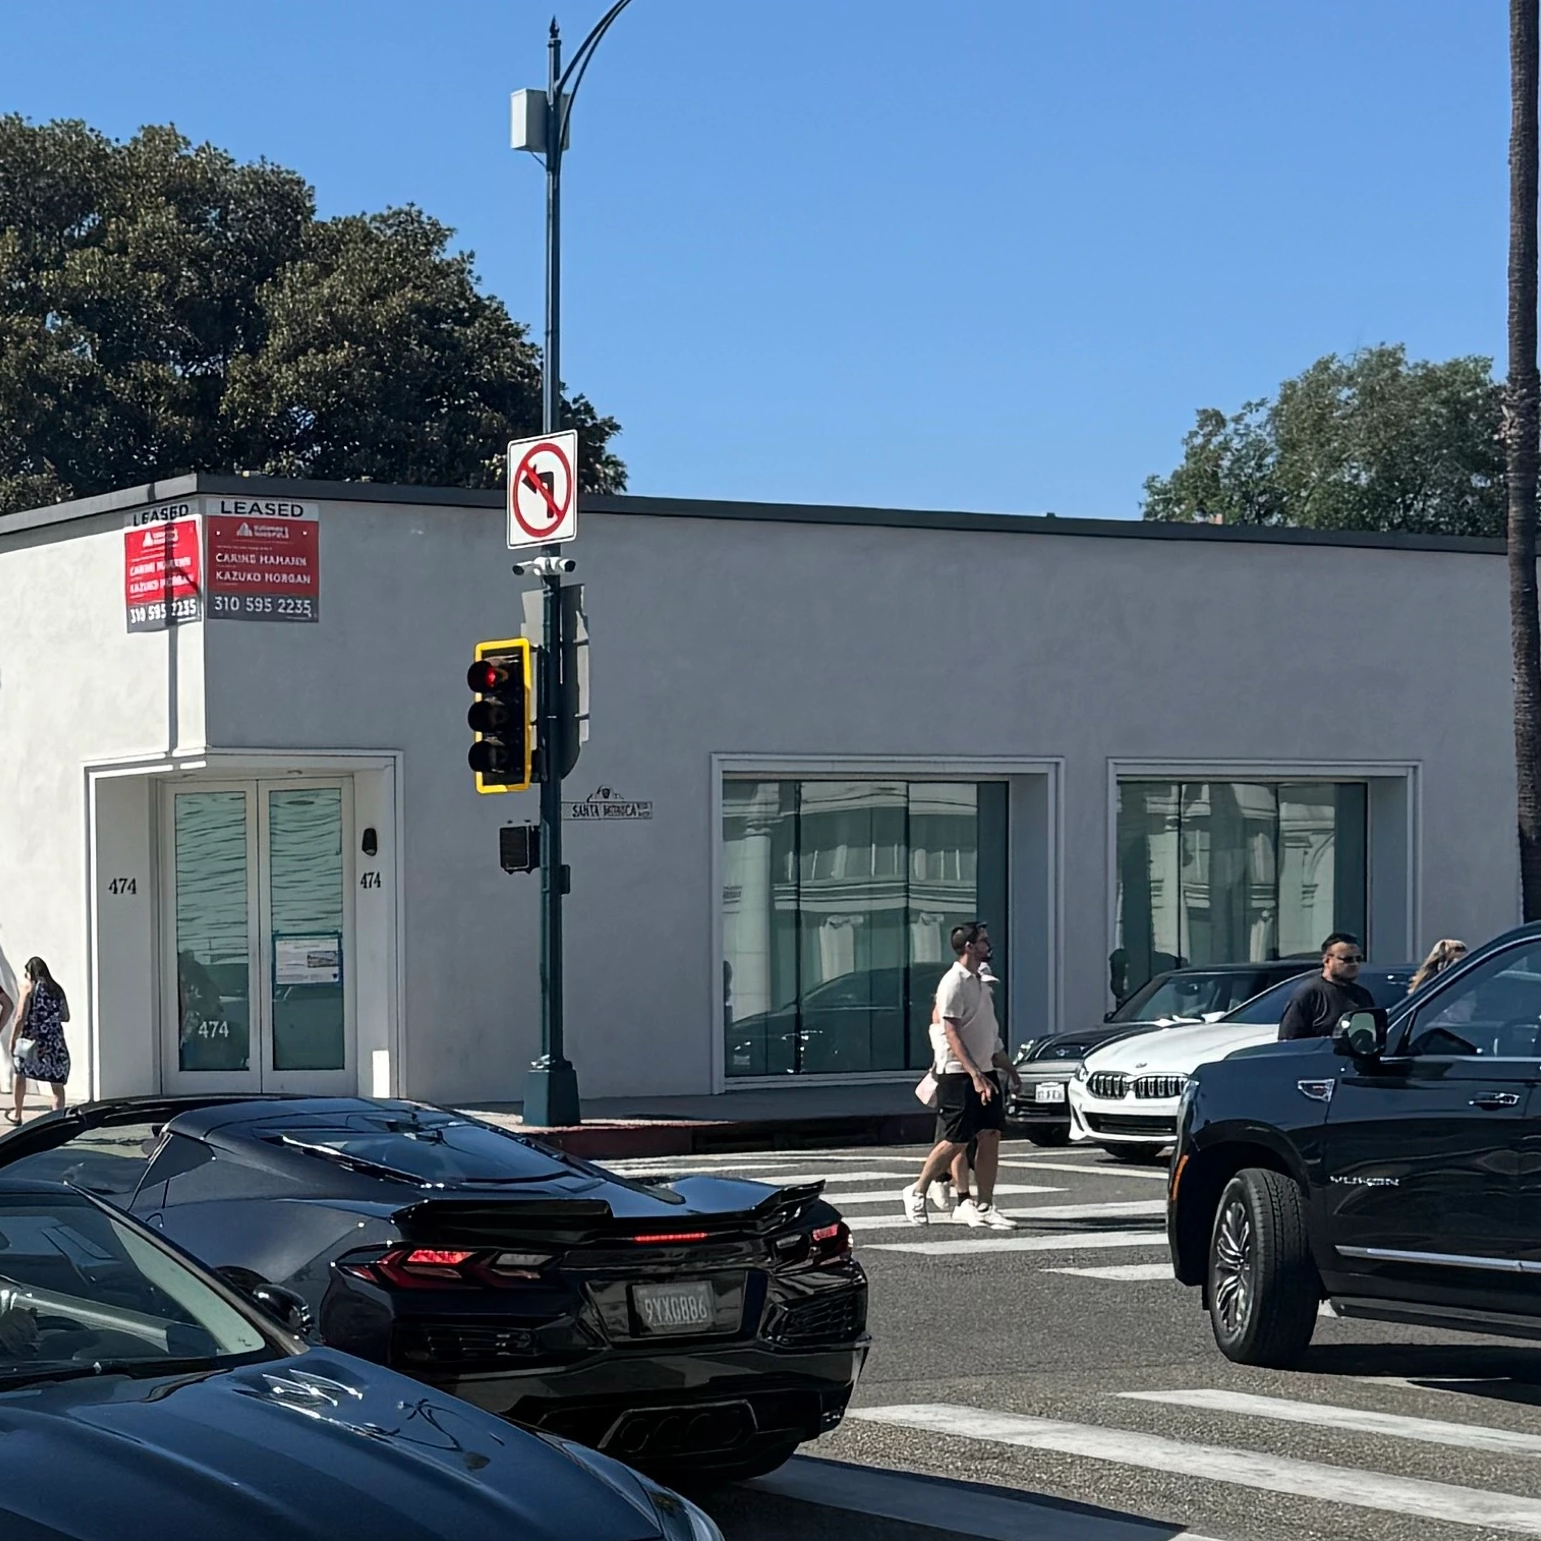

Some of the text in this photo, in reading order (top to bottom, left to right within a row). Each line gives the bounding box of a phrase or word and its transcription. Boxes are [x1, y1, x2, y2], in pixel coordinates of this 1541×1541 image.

[133, 504, 189, 527] LEASED
[220, 500, 304, 517] LEASED
[214, 596, 311, 614] 310 595 2235
[109, 878, 137, 894] 474
[360, 871, 381, 889] 474
[198, 1020, 229, 1038] 474
